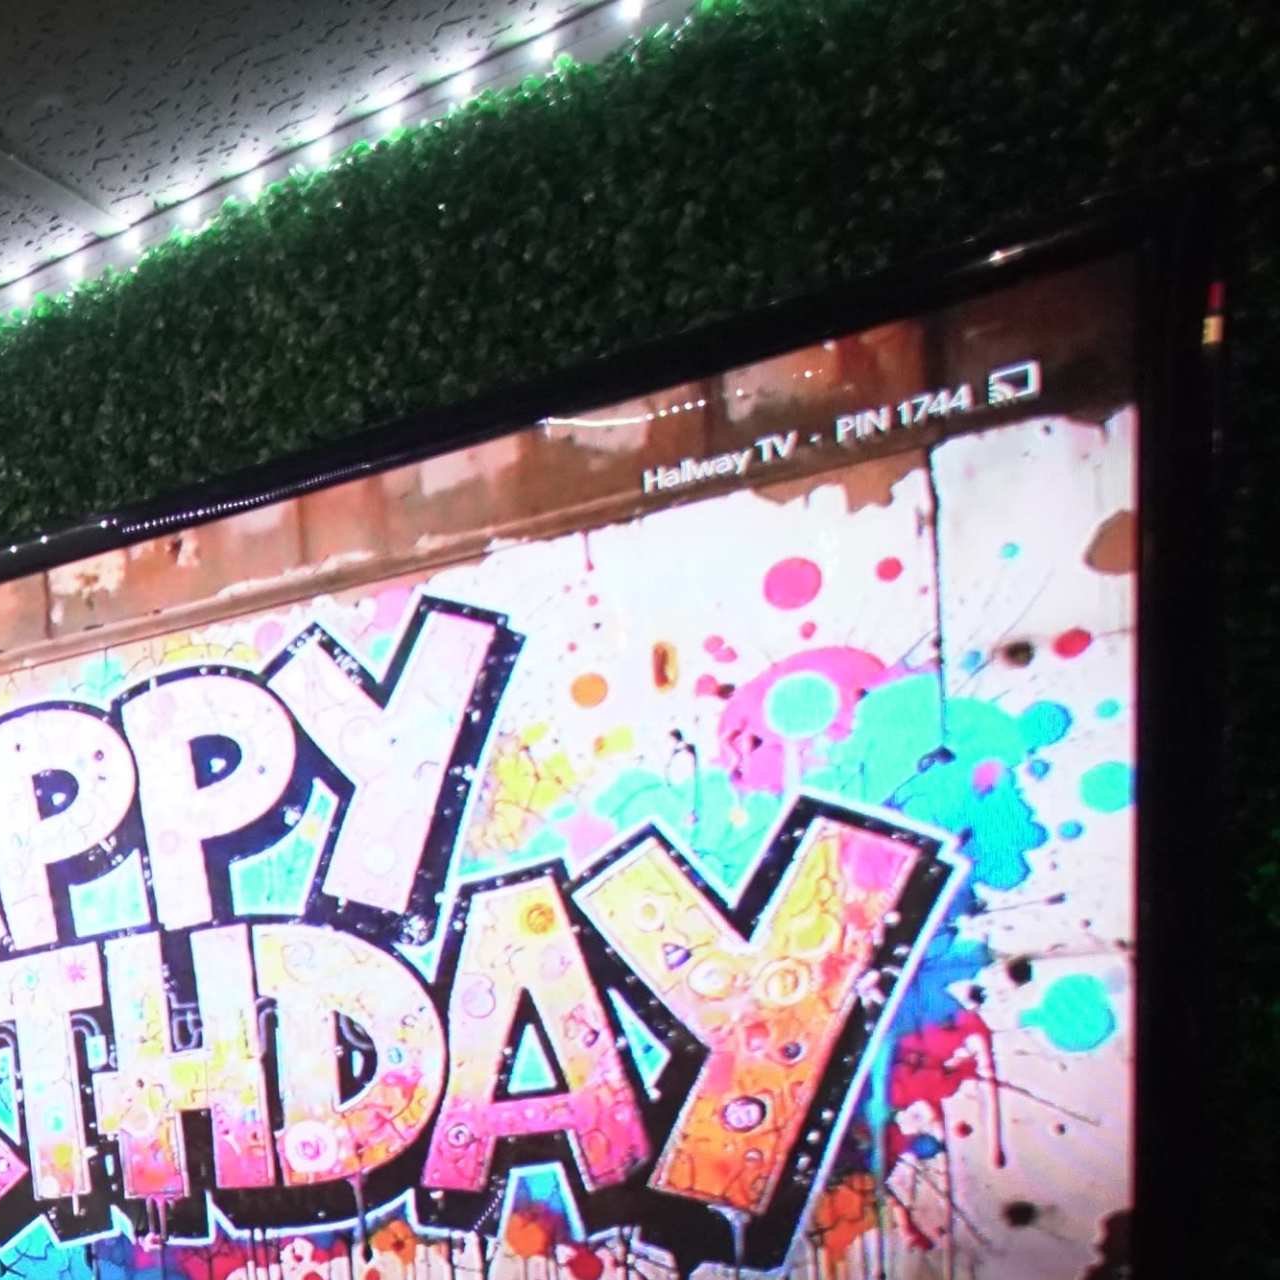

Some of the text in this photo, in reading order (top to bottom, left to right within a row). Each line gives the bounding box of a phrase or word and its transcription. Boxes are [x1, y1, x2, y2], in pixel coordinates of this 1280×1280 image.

[643, 384, 971, 494] Hallway TV PIN 1744
